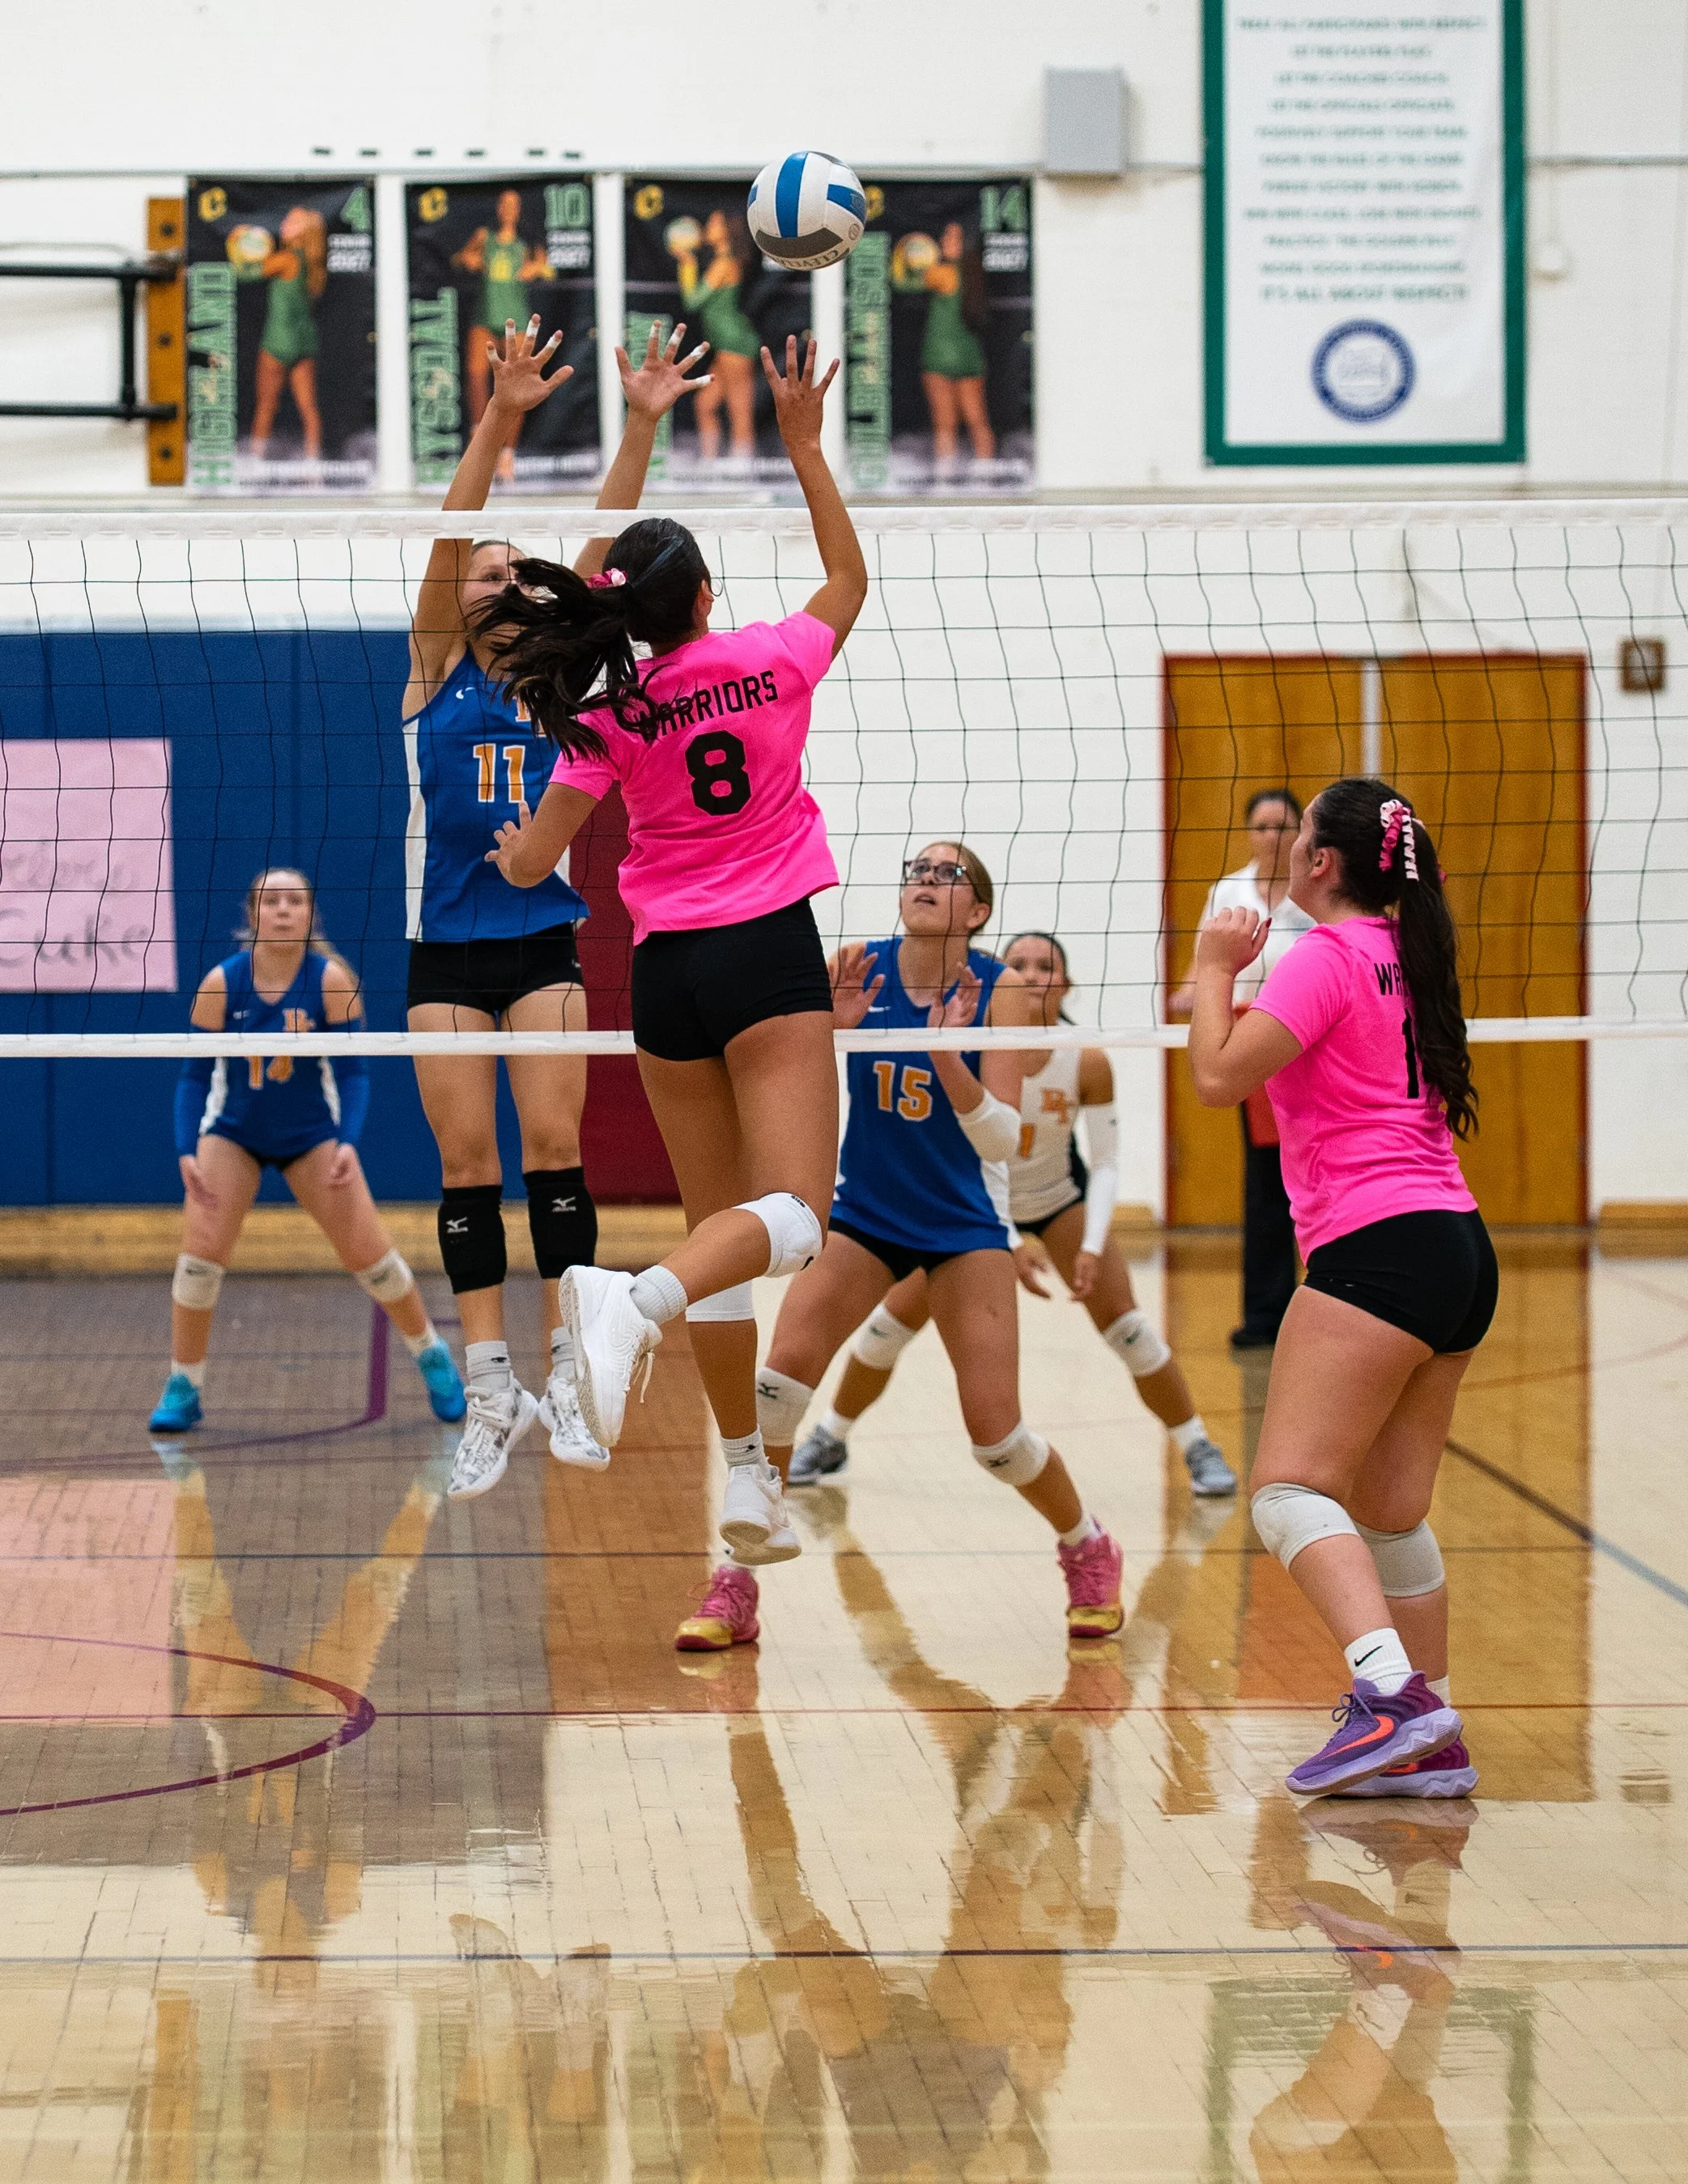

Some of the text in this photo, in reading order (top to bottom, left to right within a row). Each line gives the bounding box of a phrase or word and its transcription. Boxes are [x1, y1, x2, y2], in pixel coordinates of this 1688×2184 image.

[340, 186, 372, 232] 4
[545, 183, 591, 228] 10
[980, 186, 1028, 232] 14
[634, 670, 779, 737] ARRIORS
[473, 743, 526, 804] 11
[685, 731, 752, 816] 8
[873, 1060, 933, 1121] 15
